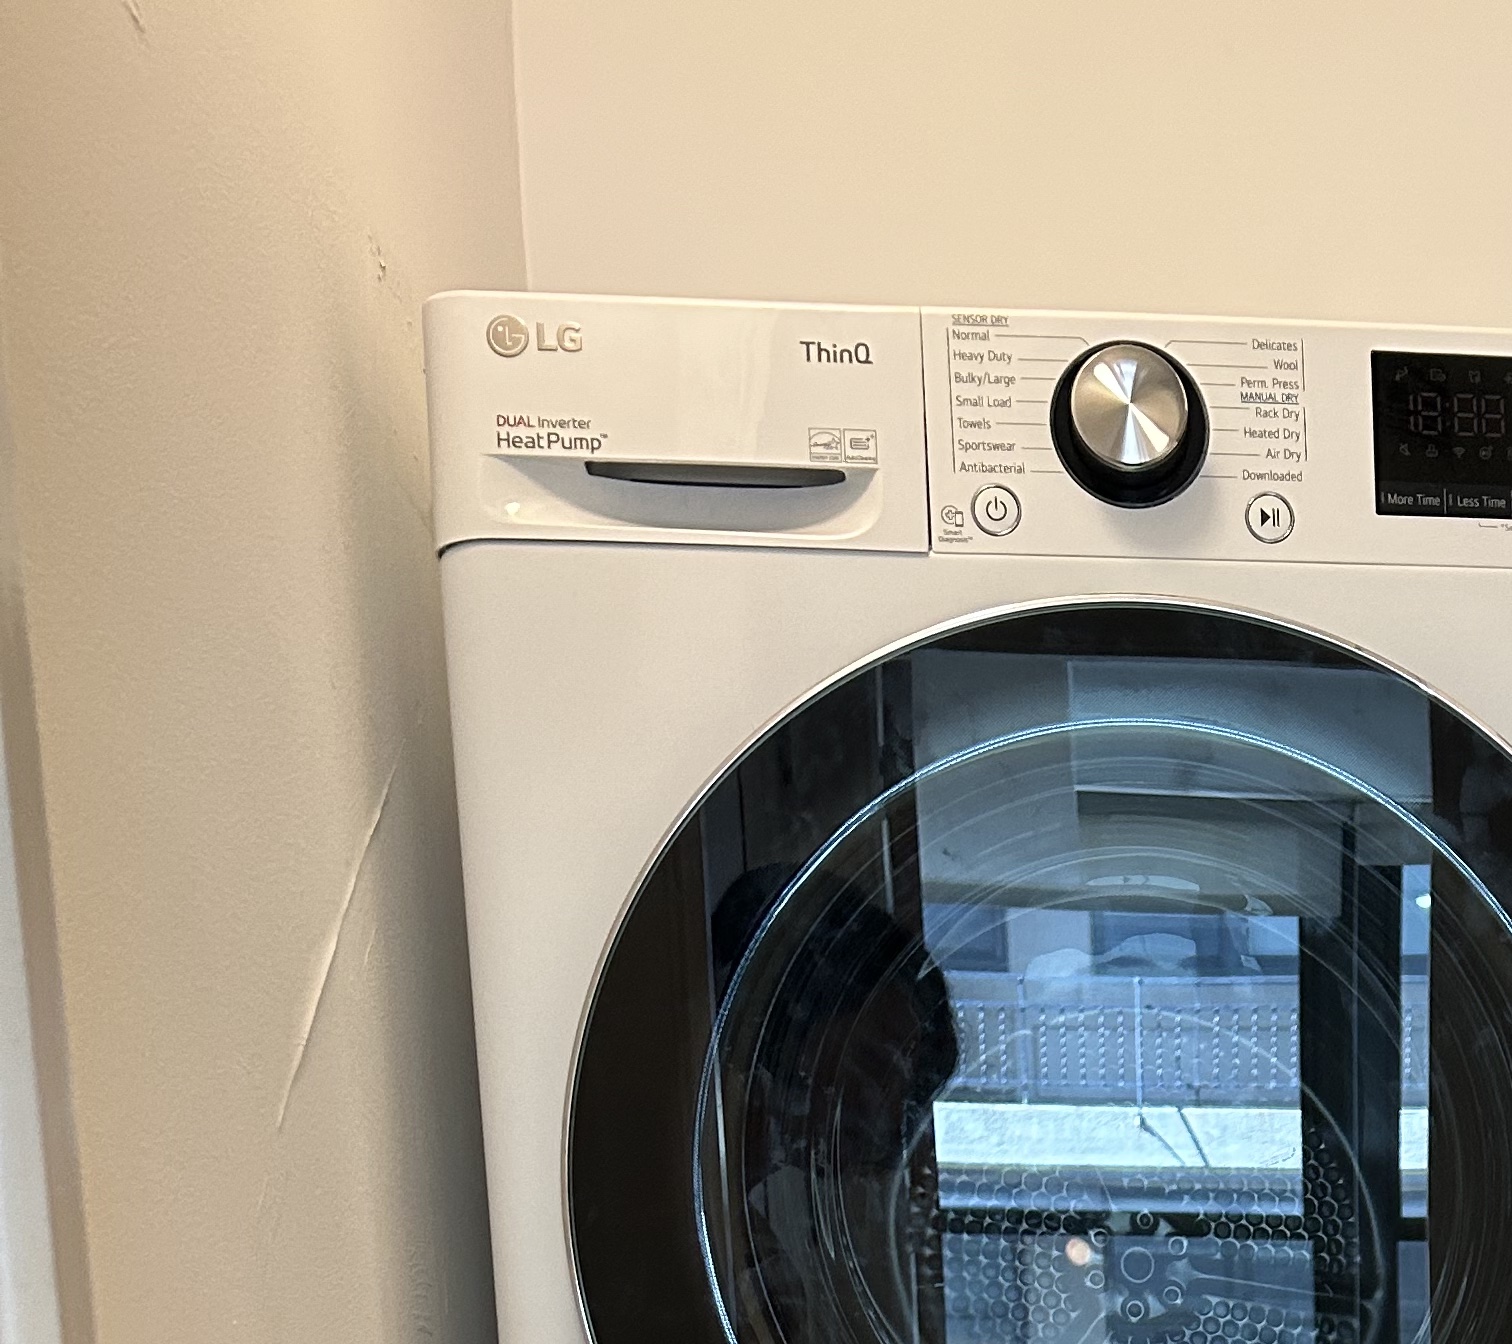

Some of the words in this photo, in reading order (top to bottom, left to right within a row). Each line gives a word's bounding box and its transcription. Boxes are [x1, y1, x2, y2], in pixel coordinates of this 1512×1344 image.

[952, 314, 988, 324] SENSOR
[990, 315, 1009, 325] DRY
[536, 321, 582, 352] LG
[952, 329, 990, 341] Normal
[1252, 338, 1298, 351] Delicates
[799, 341, 873, 364] ThinQ
[953, 349, 984, 364] Heavy
[988, 350, 1012, 365] Duty
[1273, 358, 1298, 371] Wool
[954, 371, 1016, 387] Bulky/Large
[1240, 376, 1268, 389] Perm.
[1272, 377, 1300, 390] Press
[955, 395, 984, 408] Small
[987, 396, 1012, 408] Load
[1240, 391, 1278, 402] MANUAL
[1281, 393, 1299, 403] DRY
[1255, 407, 1279, 418] Rack
[1283, 408, 1300, 422] Dry
[496, 414, 535, 428] DUAL
[537, 416, 592, 430] Inverter
[957, 418, 992, 430] Towels
[1243, 426, 1280, 439] Heated
[1283, 428, 1300, 443] Dry
[958, 439, 1016, 453] Sportswear
[1265, 448, 1280, 459] Air
[1283, 448, 1301, 463] Dry
[959, 461, 1026, 474] Antibacterial
[1242, 469, 1302, 482] Downloaded
[1388, 493, 1414, 505] More
[1416, 493, 1440, 506] Time
[1457, 495, 1480, 507] Less
[1482, 495, 1506, 509] Time
